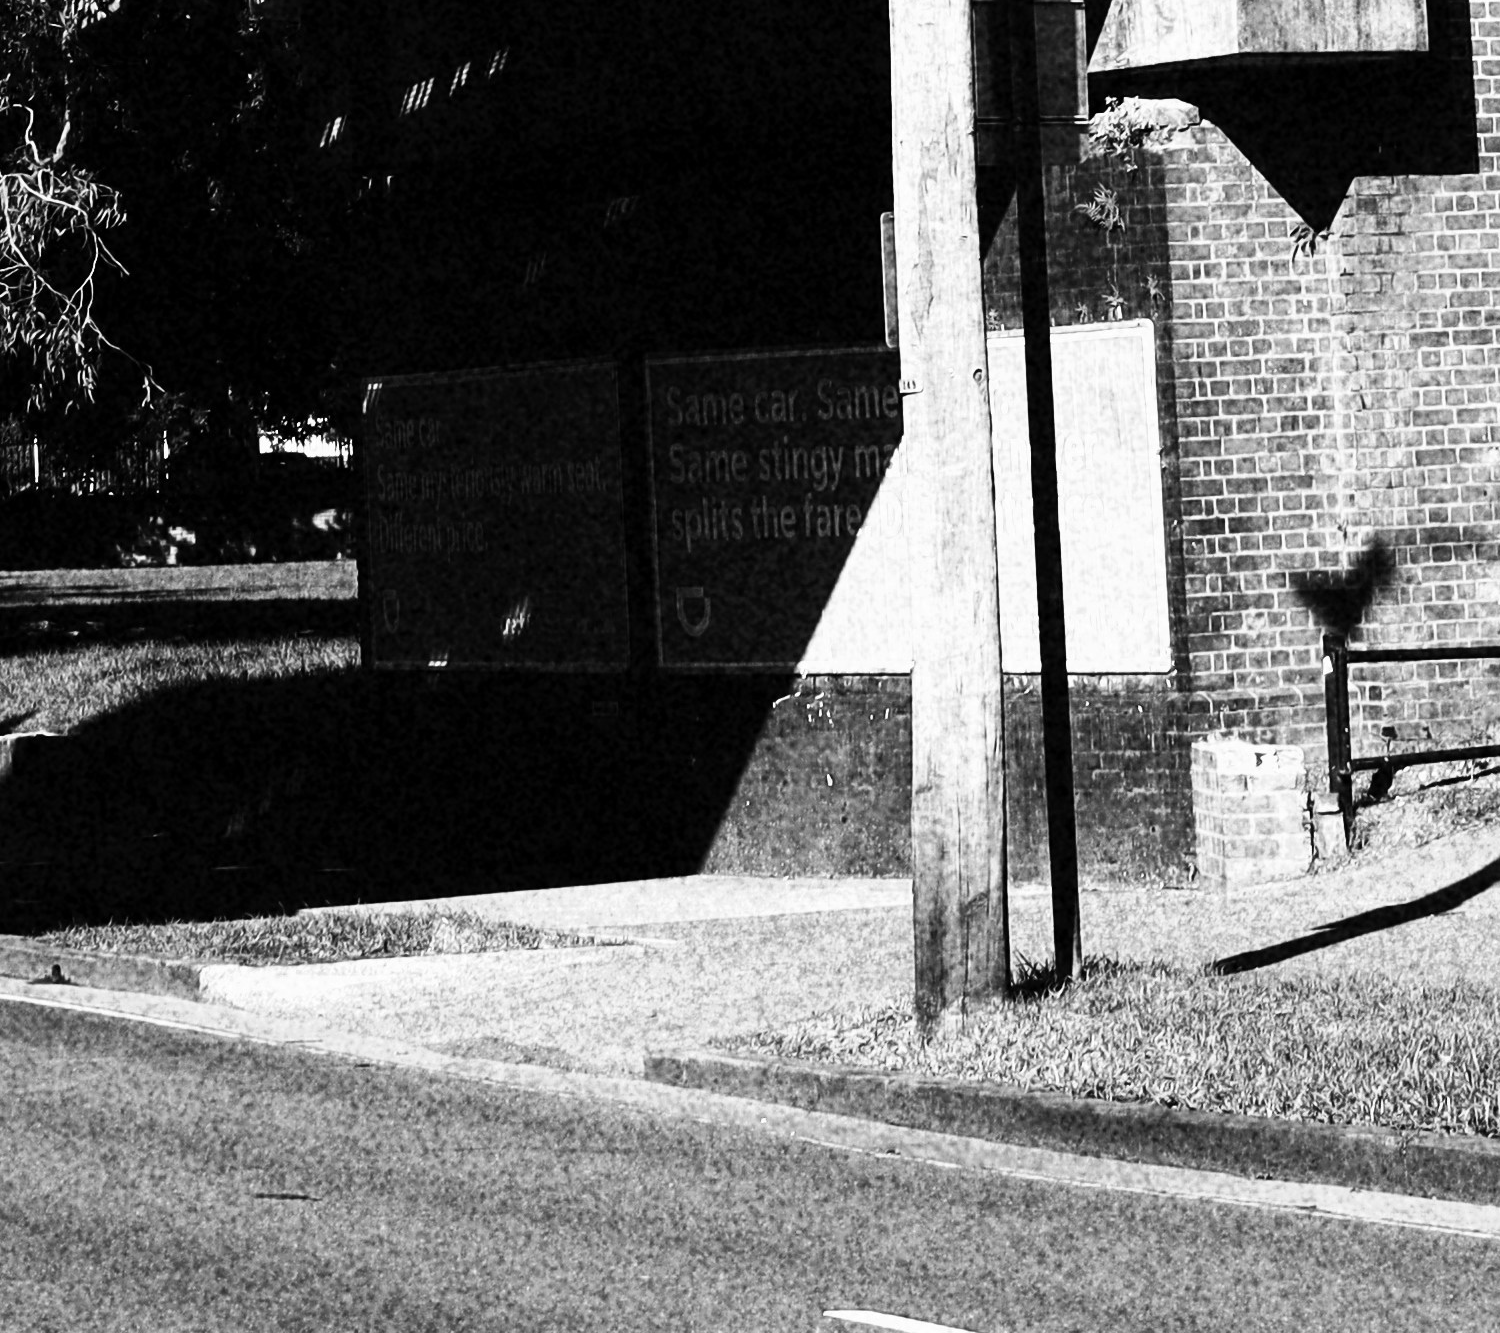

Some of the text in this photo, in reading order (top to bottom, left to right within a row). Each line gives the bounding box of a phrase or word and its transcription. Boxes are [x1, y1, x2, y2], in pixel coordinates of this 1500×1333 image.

[665, 384, 746, 427] Same
[816, 377, 900, 420] Same
[667, 442, 749, 485] Same
[758, 434, 845, 492] stingy
[671, 495, 745, 554] splits
[750, 494, 797, 540] the
